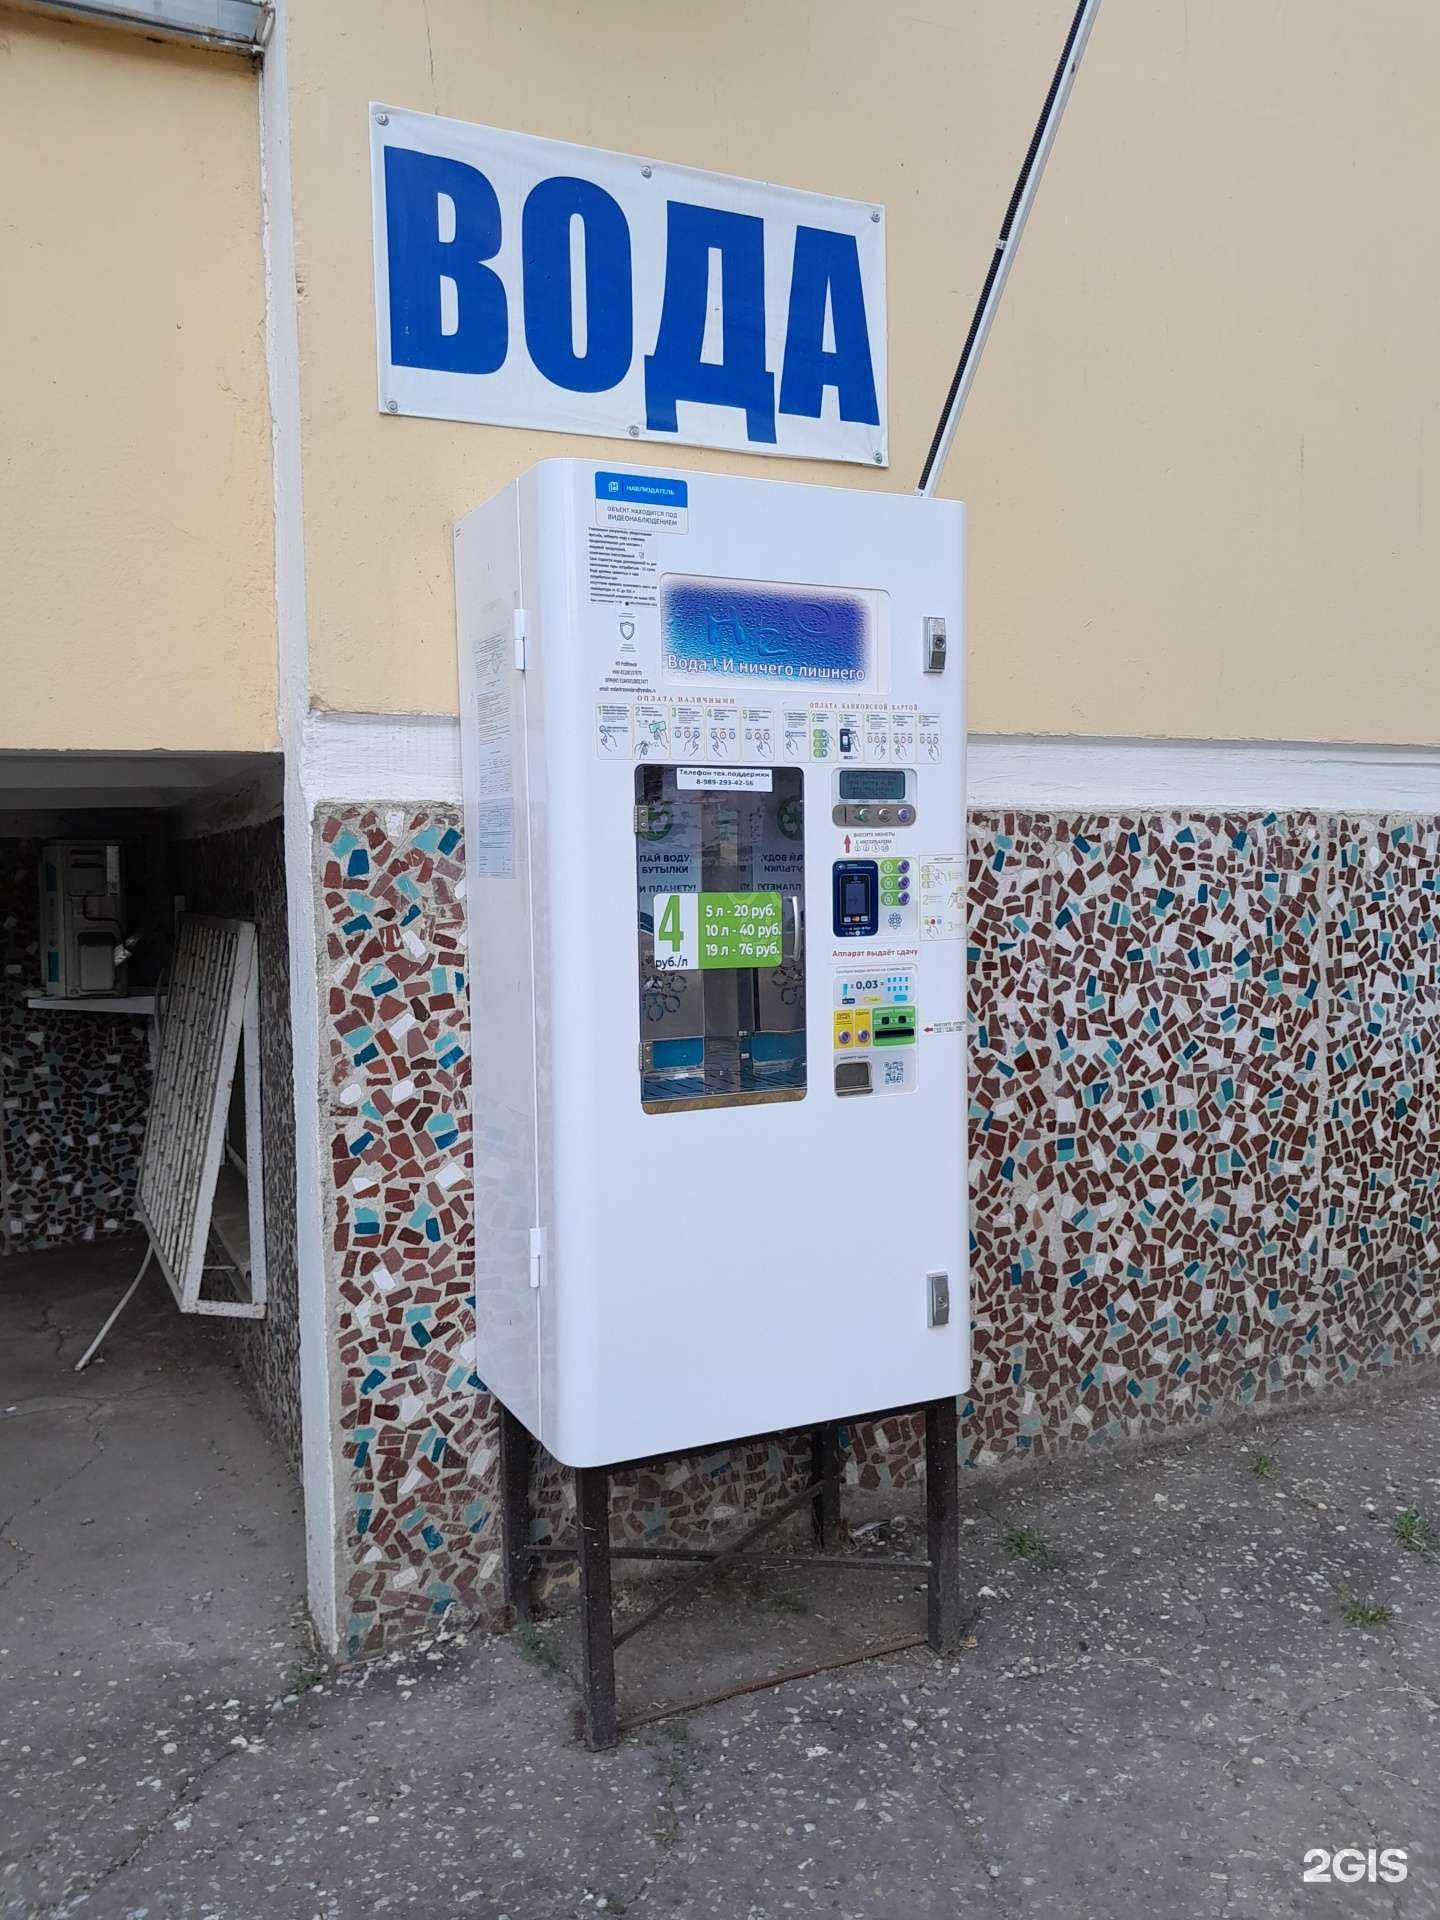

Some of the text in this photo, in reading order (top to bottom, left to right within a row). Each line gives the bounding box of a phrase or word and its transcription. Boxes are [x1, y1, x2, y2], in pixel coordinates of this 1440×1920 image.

[384, 145, 880, 444] ВОДА
[626, 485, 675, 495] НАБЛЮДАТЕЛЬ
[631, 508, 664, 517] НАХОДИТСЯ
[607, 514, 678, 526] ВИДЕОНАБЛЮДЕНИЕМ
[667, 654, 707, 672] Вода
[722, 658, 735, 671] И
[739, 661, 794, 676] ничего
[798, 666, 866, 681] лишнего
[637, 695, 735, 705] ОПЛАТА НАЛИЧНЫМИ
[809, 702, 838, 710] ОПЛАТА
[891, 703, 918, 711] КАРТОЙ
[680, 769, 712, 777] Телефон
[642, 866, 689, 874] БУТЫЛКИ
[647, 884, 697, 893] ПЛАНЕТУ!
[705, 905, 713, 917] 5
[715, 907, 724, 917] л
[733, 905, 748, 917] 20
[751, 905, 776, 920] руб.
[658, 895, 685, 953] 4
[705, 924, 719, 936] 10
[720, 926, 729, 937] л
[739, 924, 755, 936] 40
[757, 924, 782, 938] руб.
[705, 943, 719, 956] 19
[720, 946, 729, 956] л
[739, 943, 753, 955] 76
[755, 943, 780, 958] руб.
[832, 949, 918, 959] Аппарат выдаёт сдачу
[655, 956, 688, 970] руб./л
[855, 979, 879, 992] 0,03
